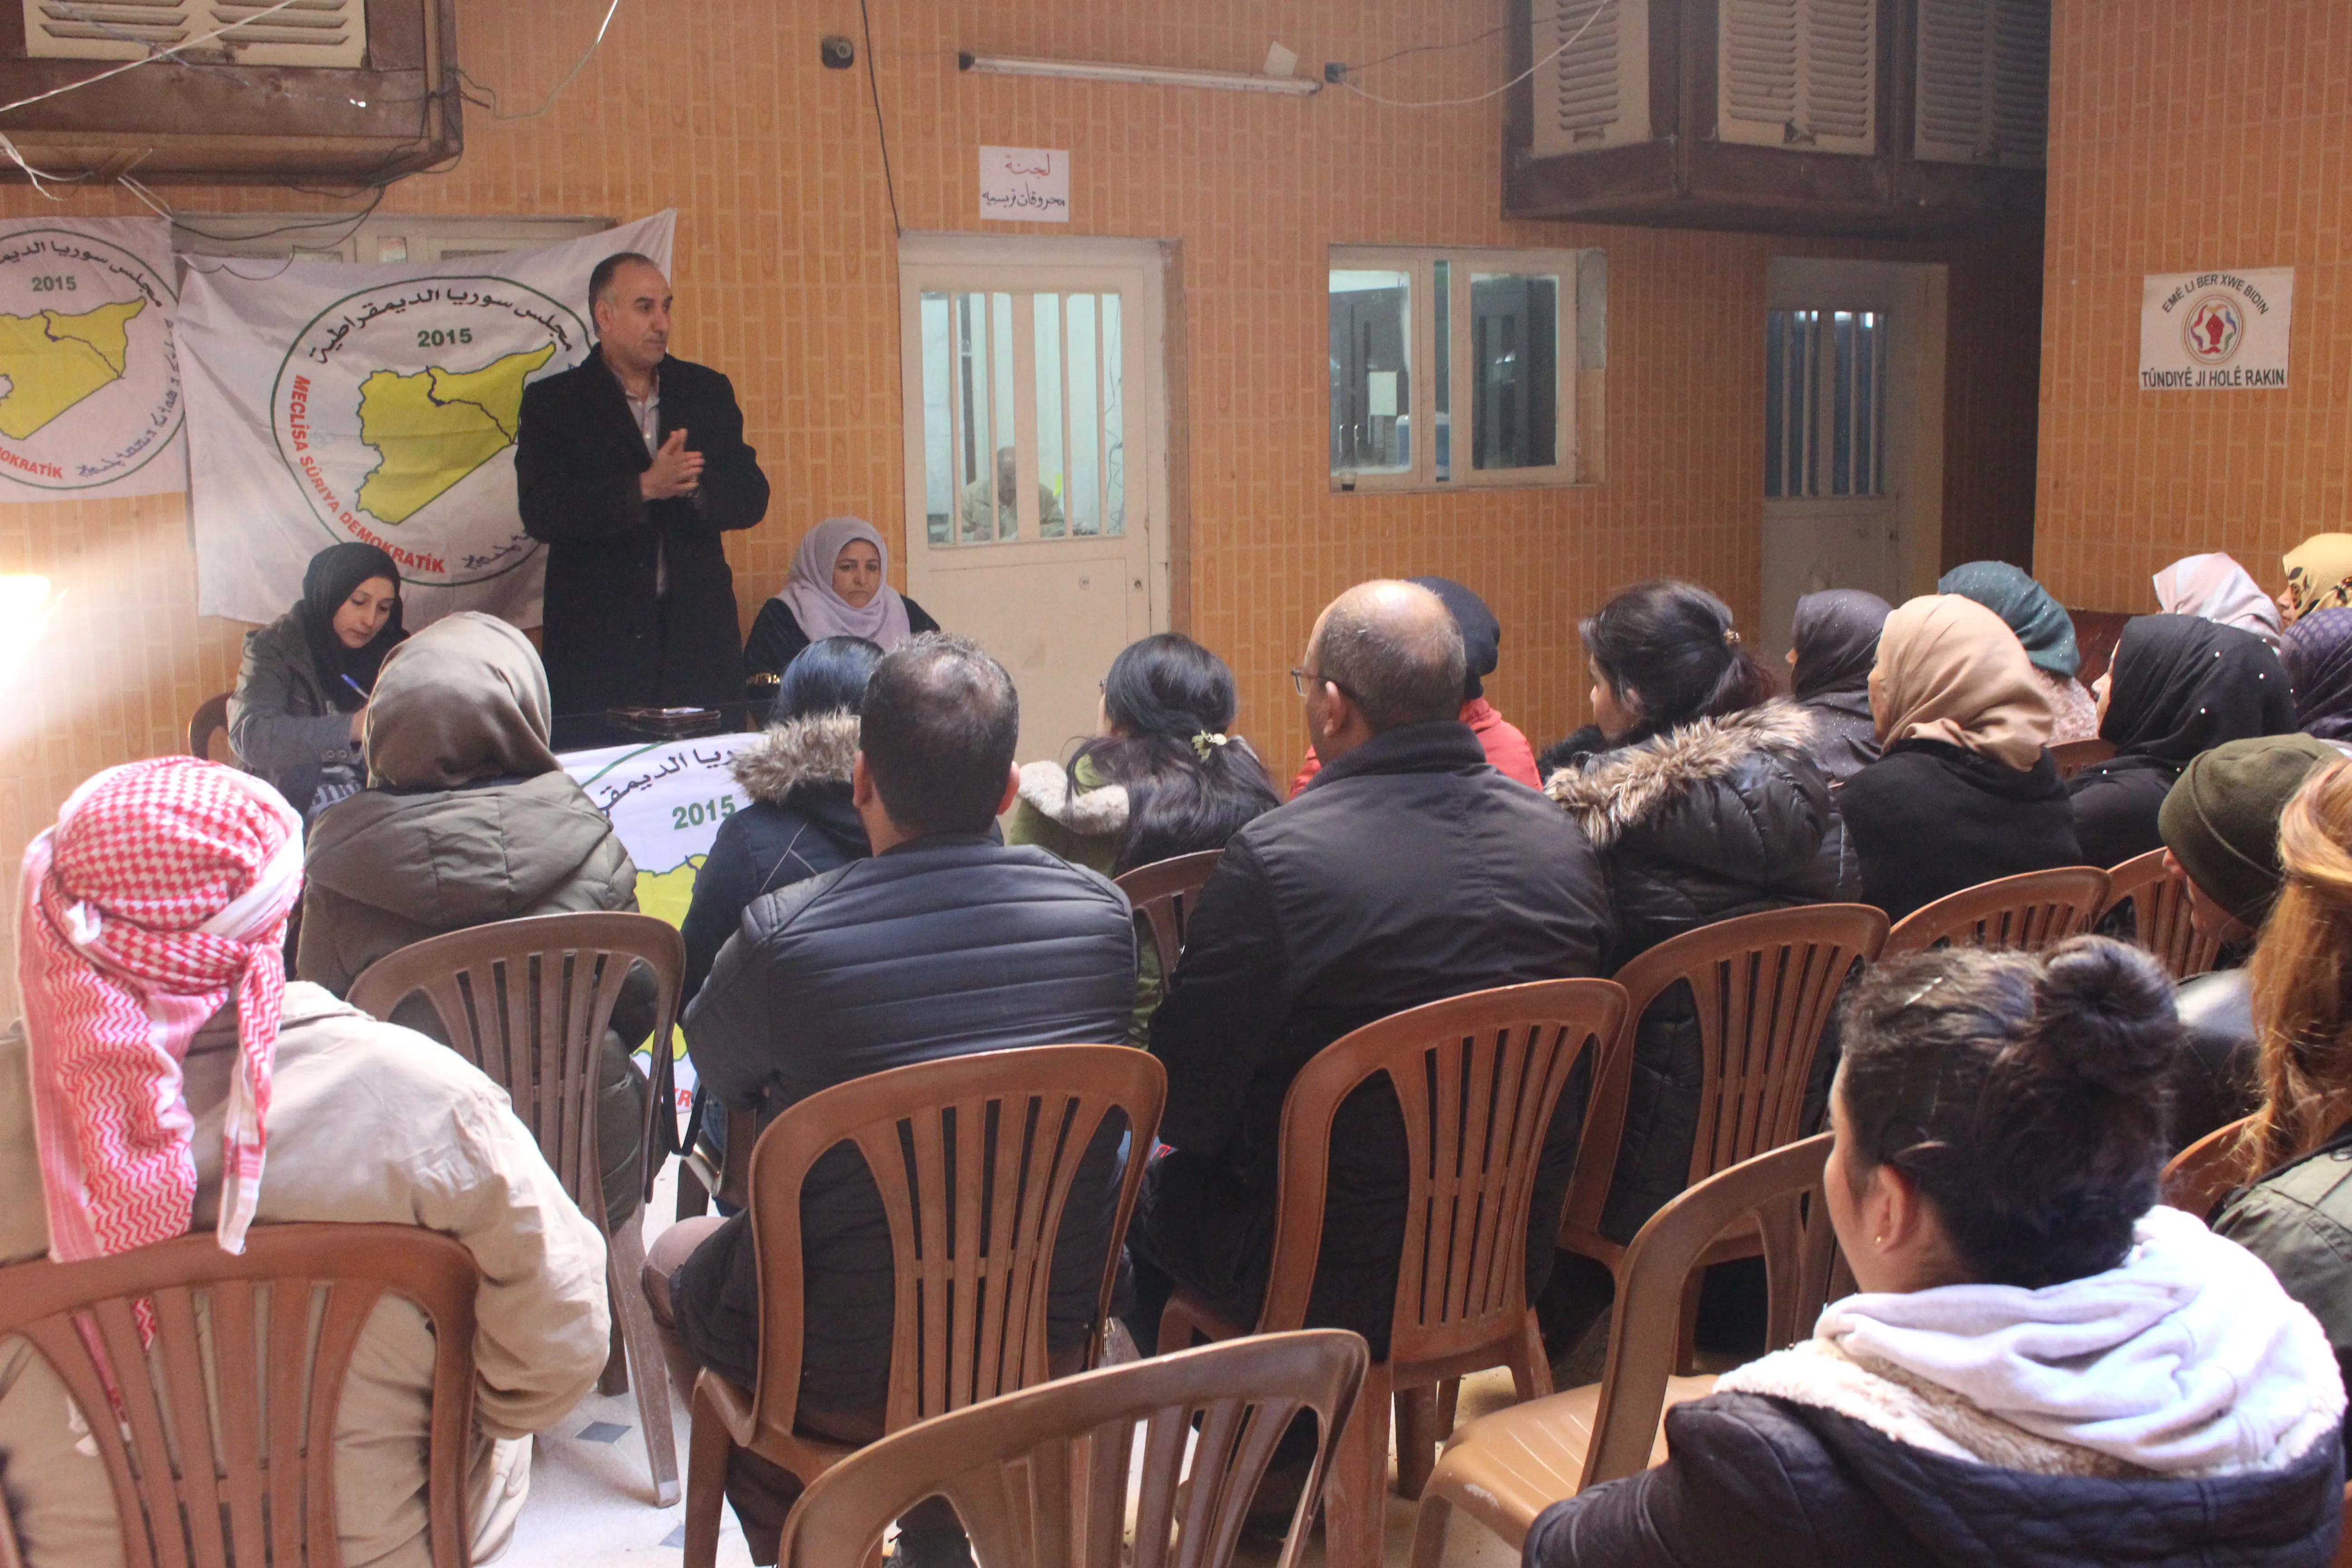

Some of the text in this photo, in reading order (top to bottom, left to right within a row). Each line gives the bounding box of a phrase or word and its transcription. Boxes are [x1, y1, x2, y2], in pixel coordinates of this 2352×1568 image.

[1005, 152, 1050, 180] لجنة
[51, 241, 108, 261] سوريا
[32, 275, 77, 292] 2015
[109, 265, 162, 308] مجلس
[2185, 280, 2195, 294] LI
[2197, 274, 2218, 288] BER
[2220, 274, 2245, 291] XWE
[2244, 284, 2269, 315] BIDIN
[309, 288, 572, 364] مجلس سوريا الديمقراطية
[417, 328, 473, 348] 2015
[2196, 370, 2206, 387] JI
[2210, 365, 2242, 387] HOLÊ
[2245, 368, 2285, 386] RAKIN
[672, 794, 736, 830] 2015
